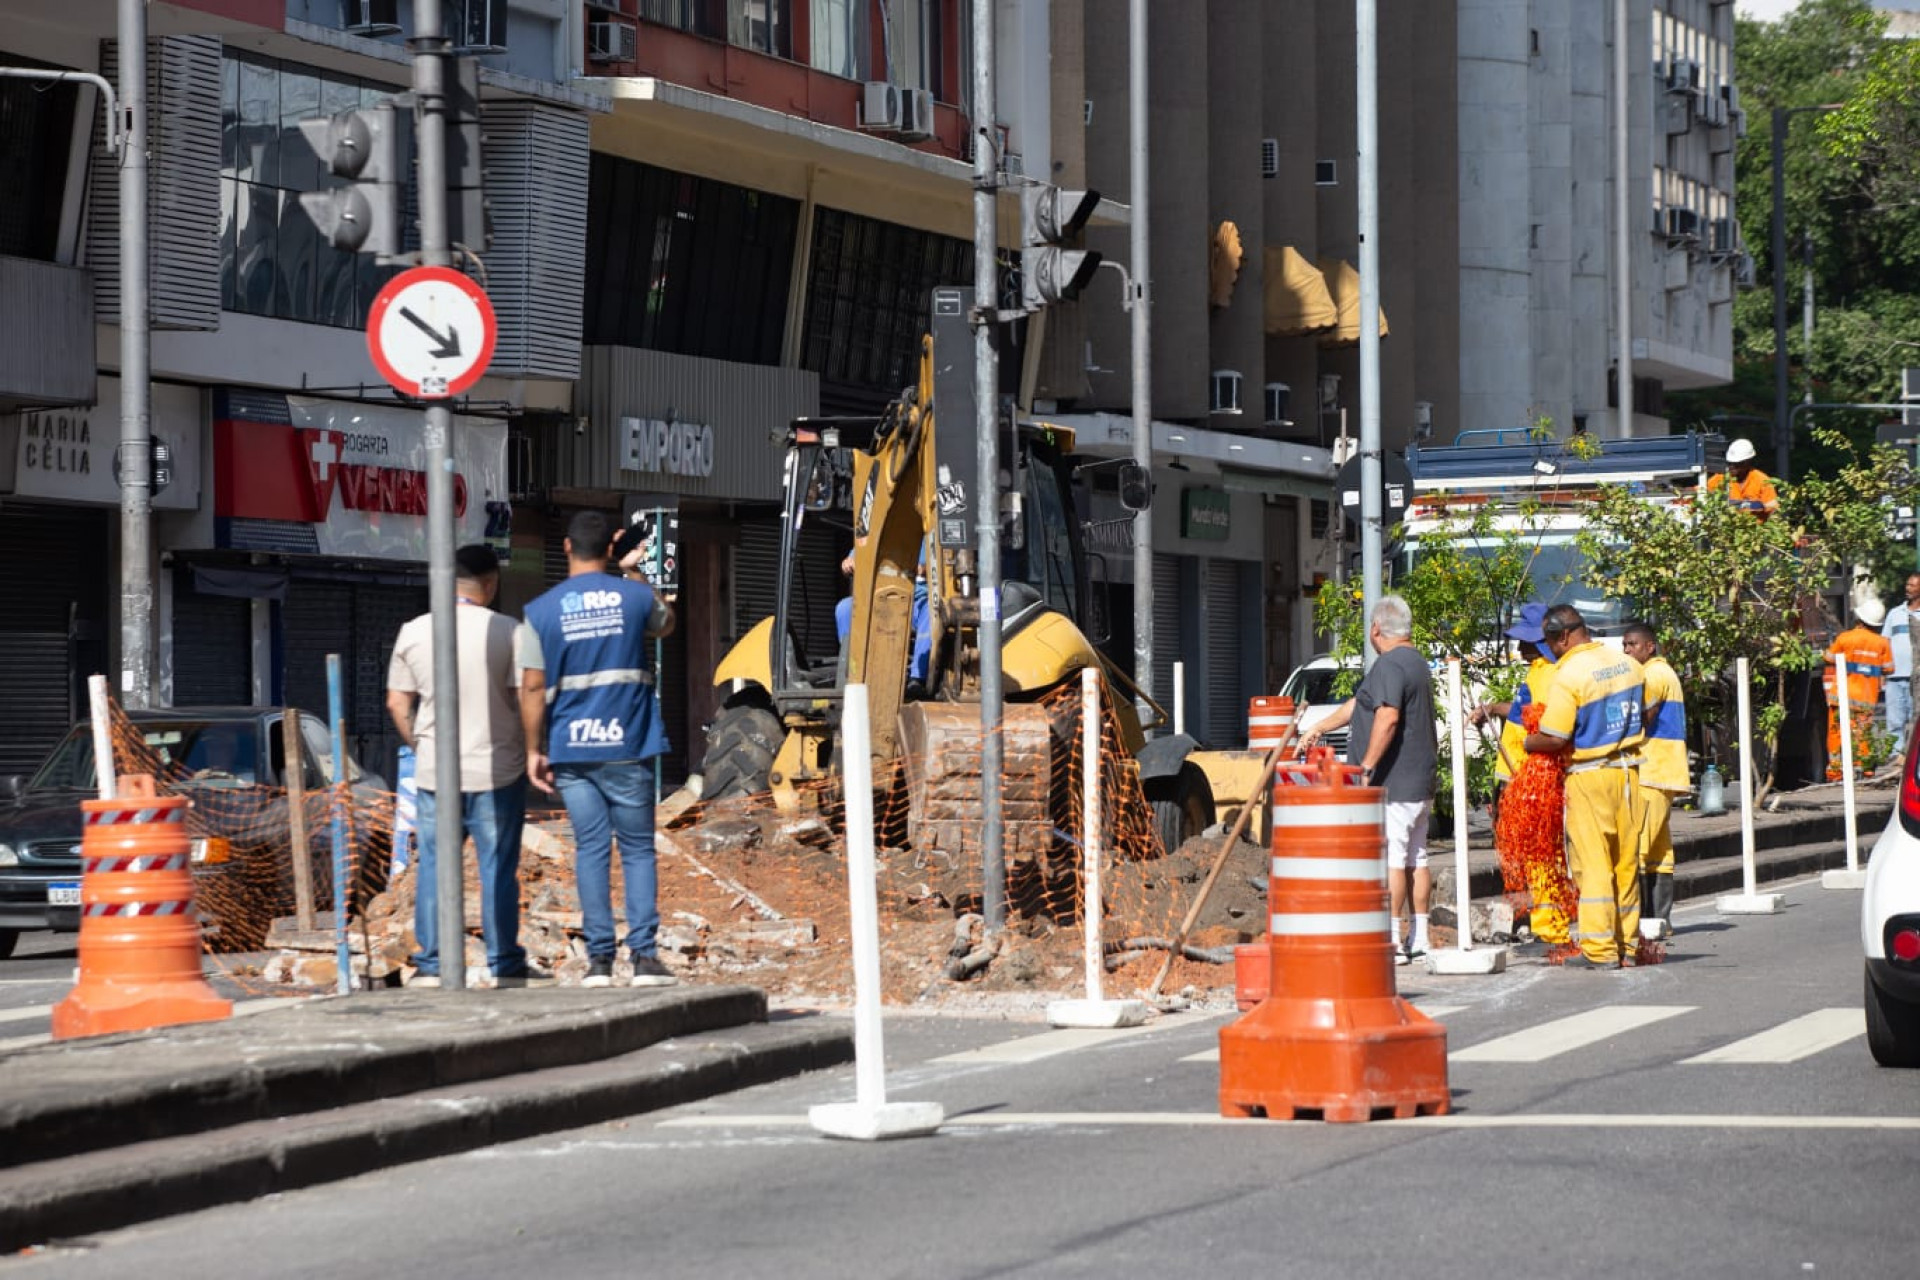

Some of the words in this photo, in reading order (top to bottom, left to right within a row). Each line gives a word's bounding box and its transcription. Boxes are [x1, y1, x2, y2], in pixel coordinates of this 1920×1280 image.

[27, 413, 90, 444] MARIA
[343, 432, 389, 456] ROGARIA
[570, 718, 624, 742] 1746
